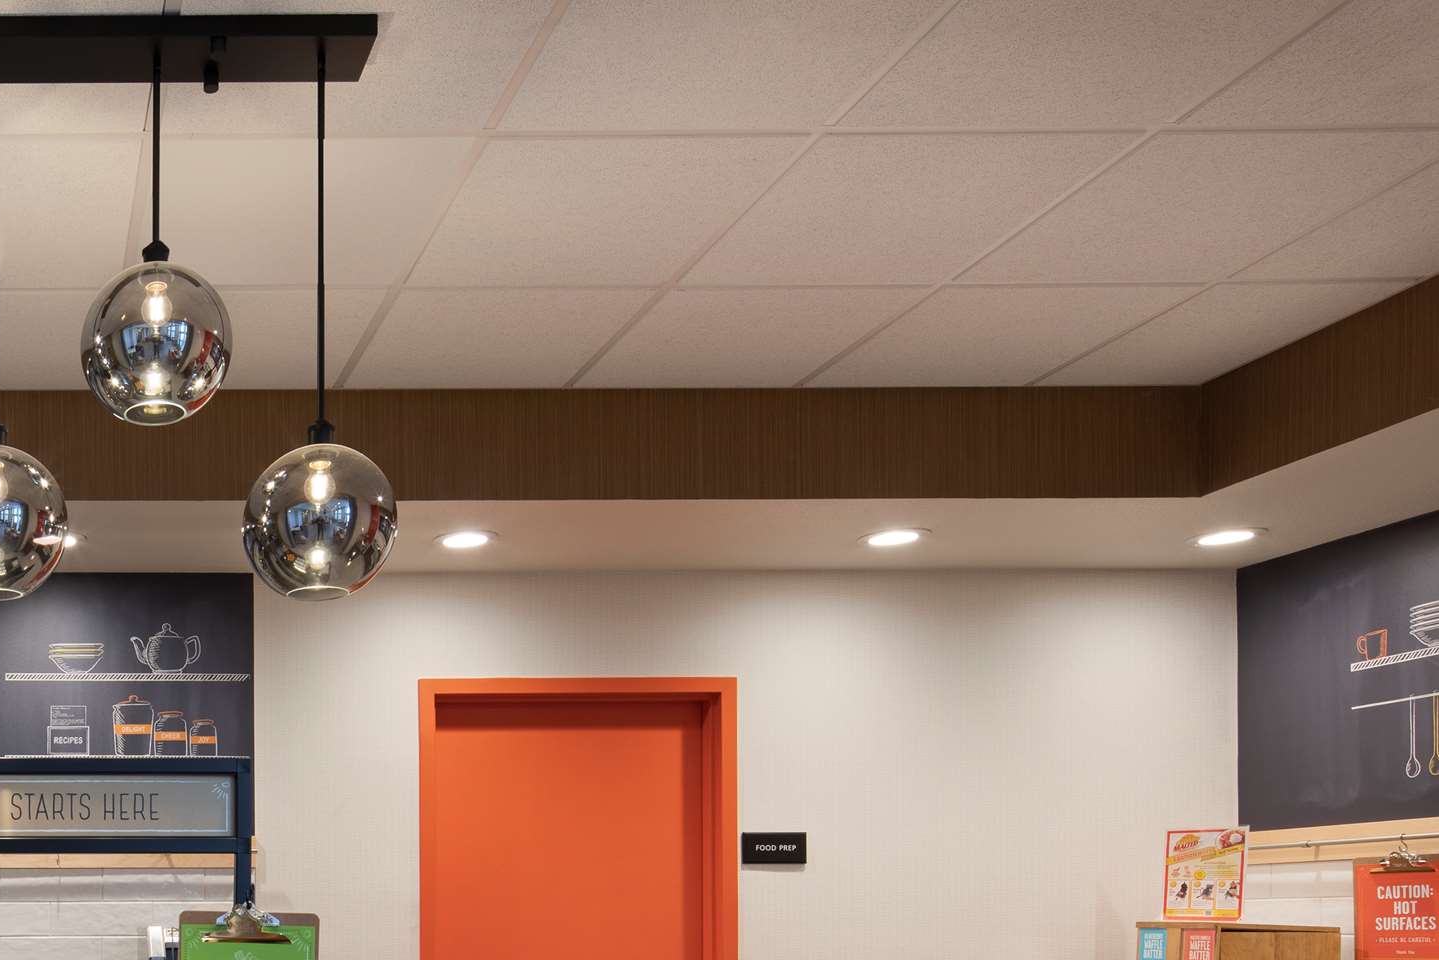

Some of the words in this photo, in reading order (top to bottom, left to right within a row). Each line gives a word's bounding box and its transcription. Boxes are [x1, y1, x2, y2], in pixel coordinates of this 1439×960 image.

[10, 792, 91, 821] STARTS
[103, 792, 160, 821] HERE
[1376, 884, 1434, 900] CAUTION:
[1394, 901, 1418, 915] HOT
[1376, 916, 1436, 931] SURFACES
[1190, 940, 1210, 950] WAFFLE
[1189, 950, 1210, 960] BATTER
